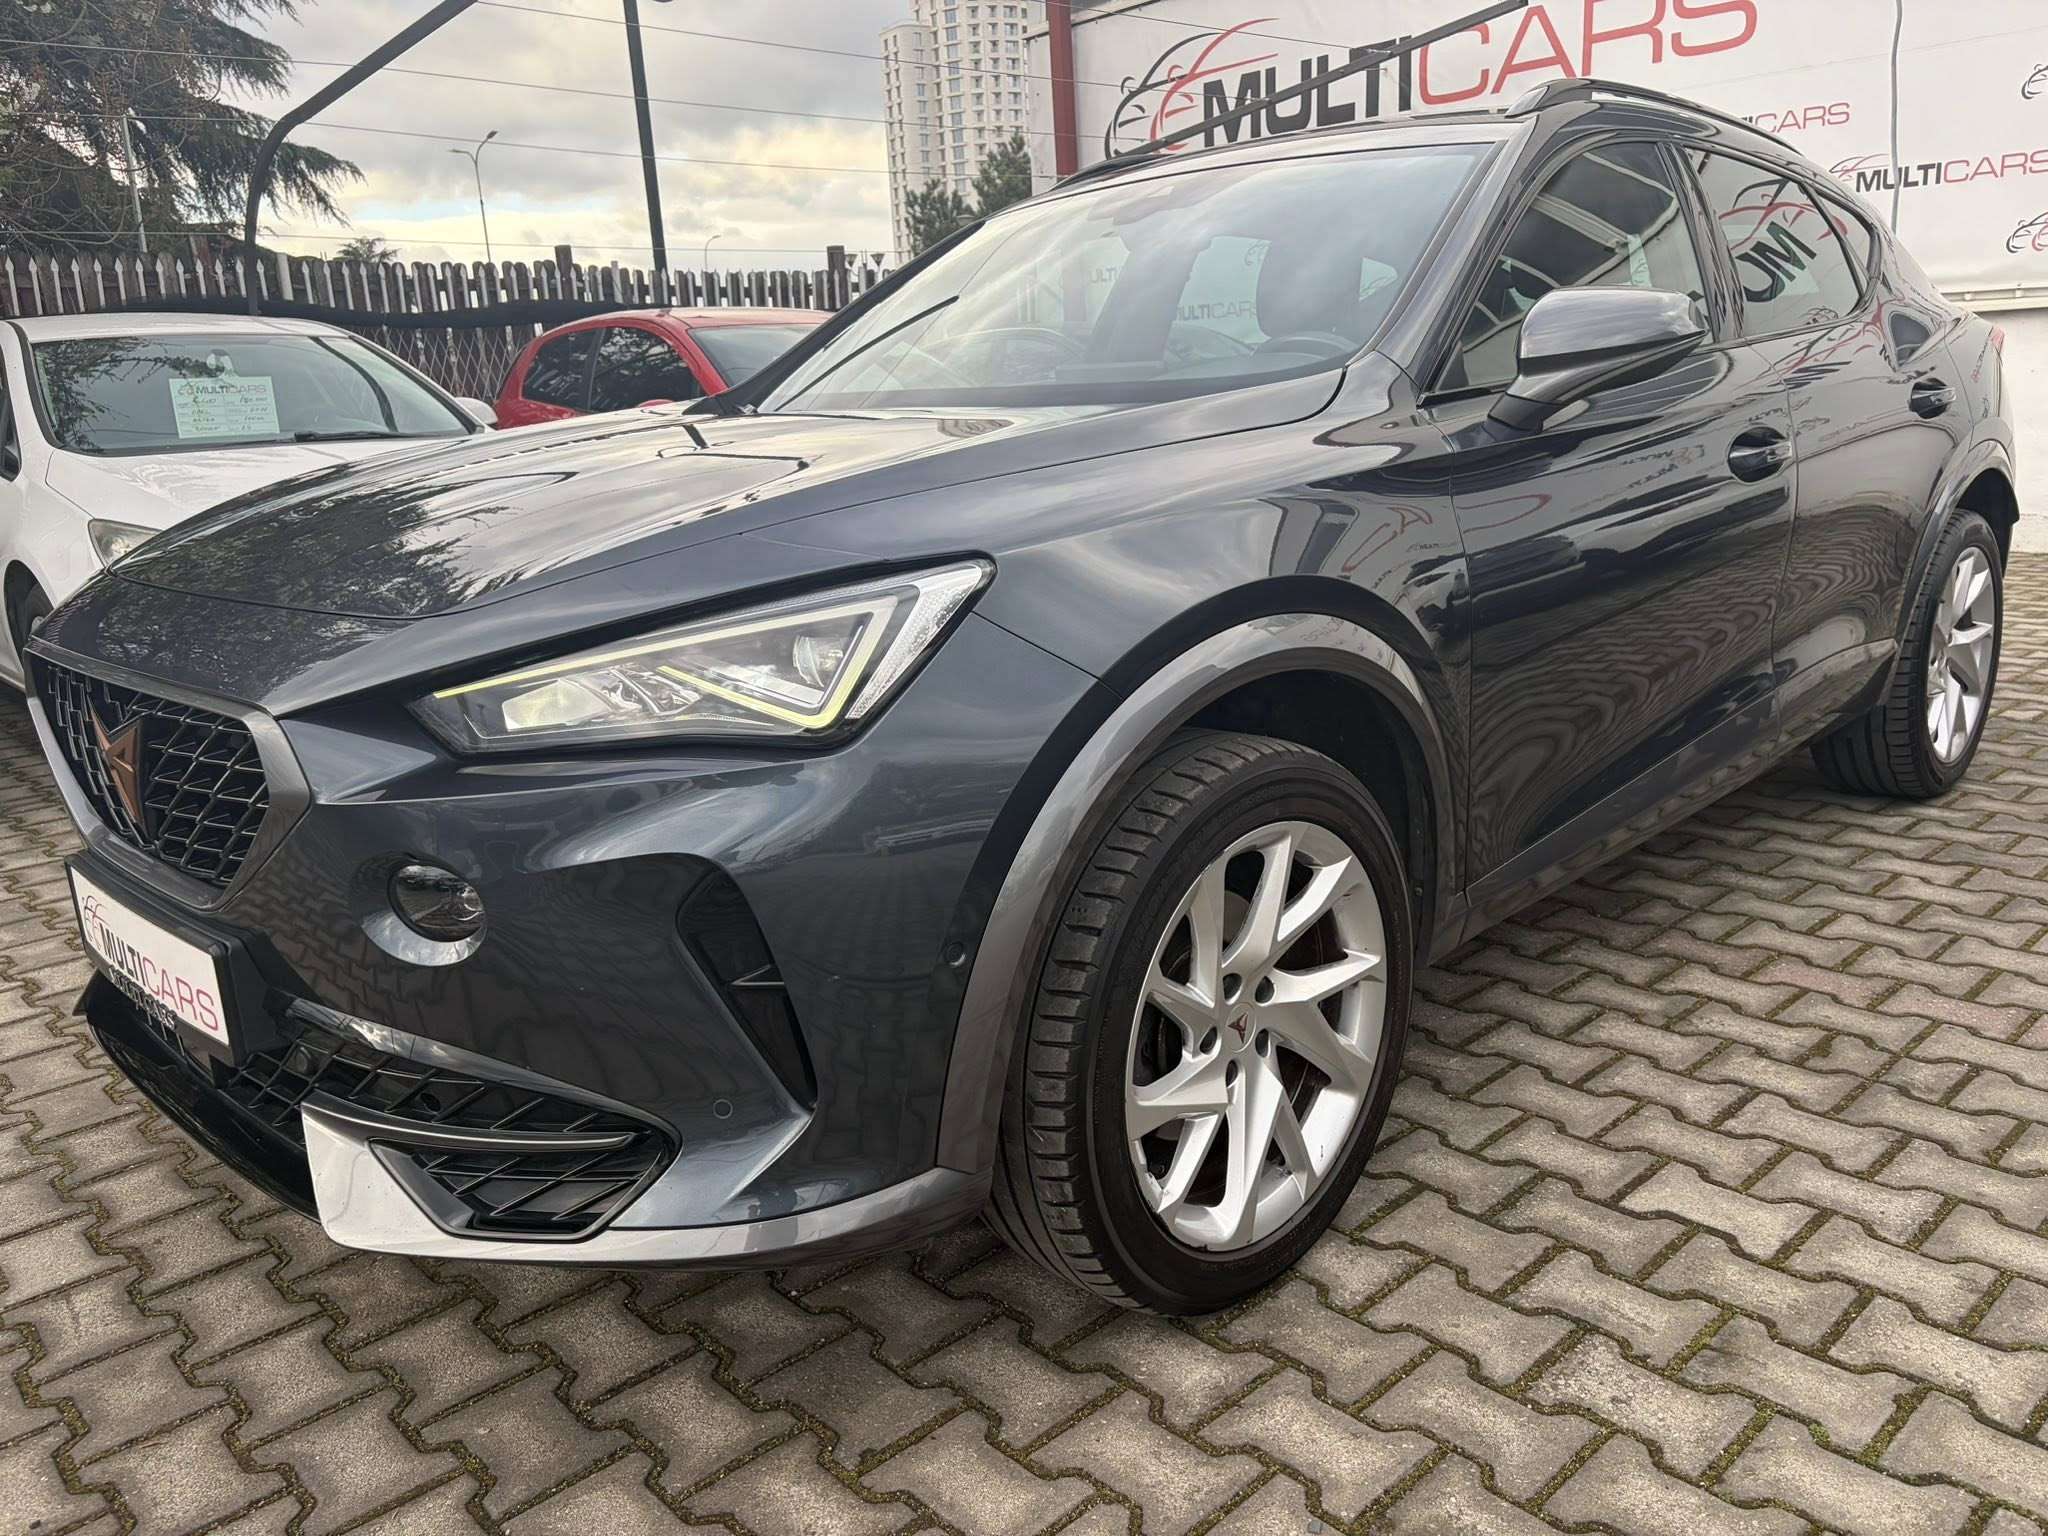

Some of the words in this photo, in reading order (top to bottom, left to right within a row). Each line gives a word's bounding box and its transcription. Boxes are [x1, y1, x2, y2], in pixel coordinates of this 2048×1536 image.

[1203, 0, 1759, 148] MULTICARS
[1741, 102, 1850, 133] CARS
[1855, 150, 2048, 193] MULTICARS
[1177, 300, 1257, 321] ULTICAR
[195, 384, 267, 395] MULTICARS
[100, 922, 219, 1031] MULTICARS
